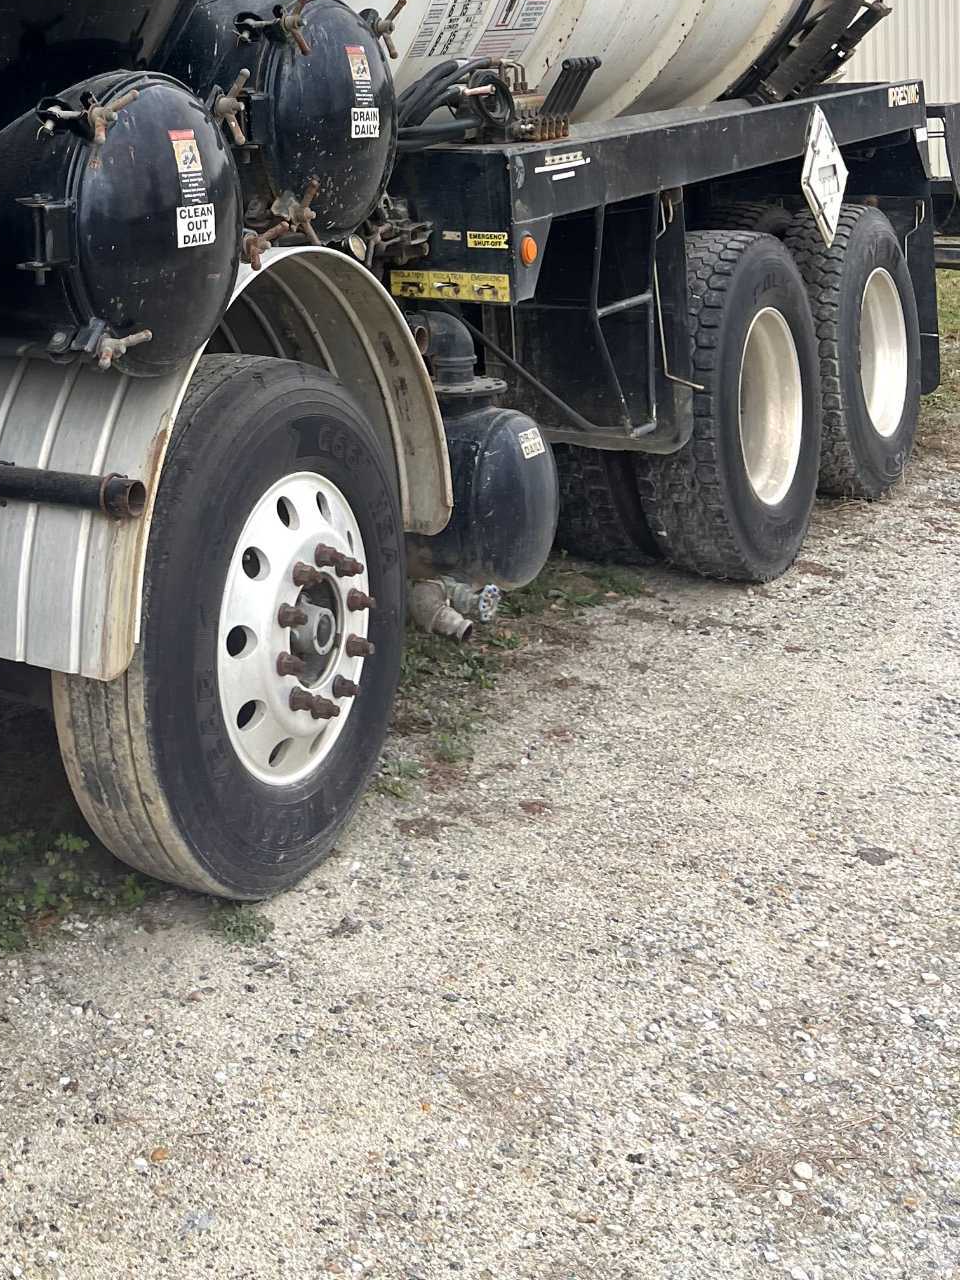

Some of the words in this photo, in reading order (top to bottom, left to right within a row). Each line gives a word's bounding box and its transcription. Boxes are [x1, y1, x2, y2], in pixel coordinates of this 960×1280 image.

[352, 111, 378, 122] DRAIN
[354, 124, 378, 135] DAILY
[179, 206, 213, 220] CLEAN
[187, 219, 209, 232] OUT
[183, 231, 212, 245] DAILY
